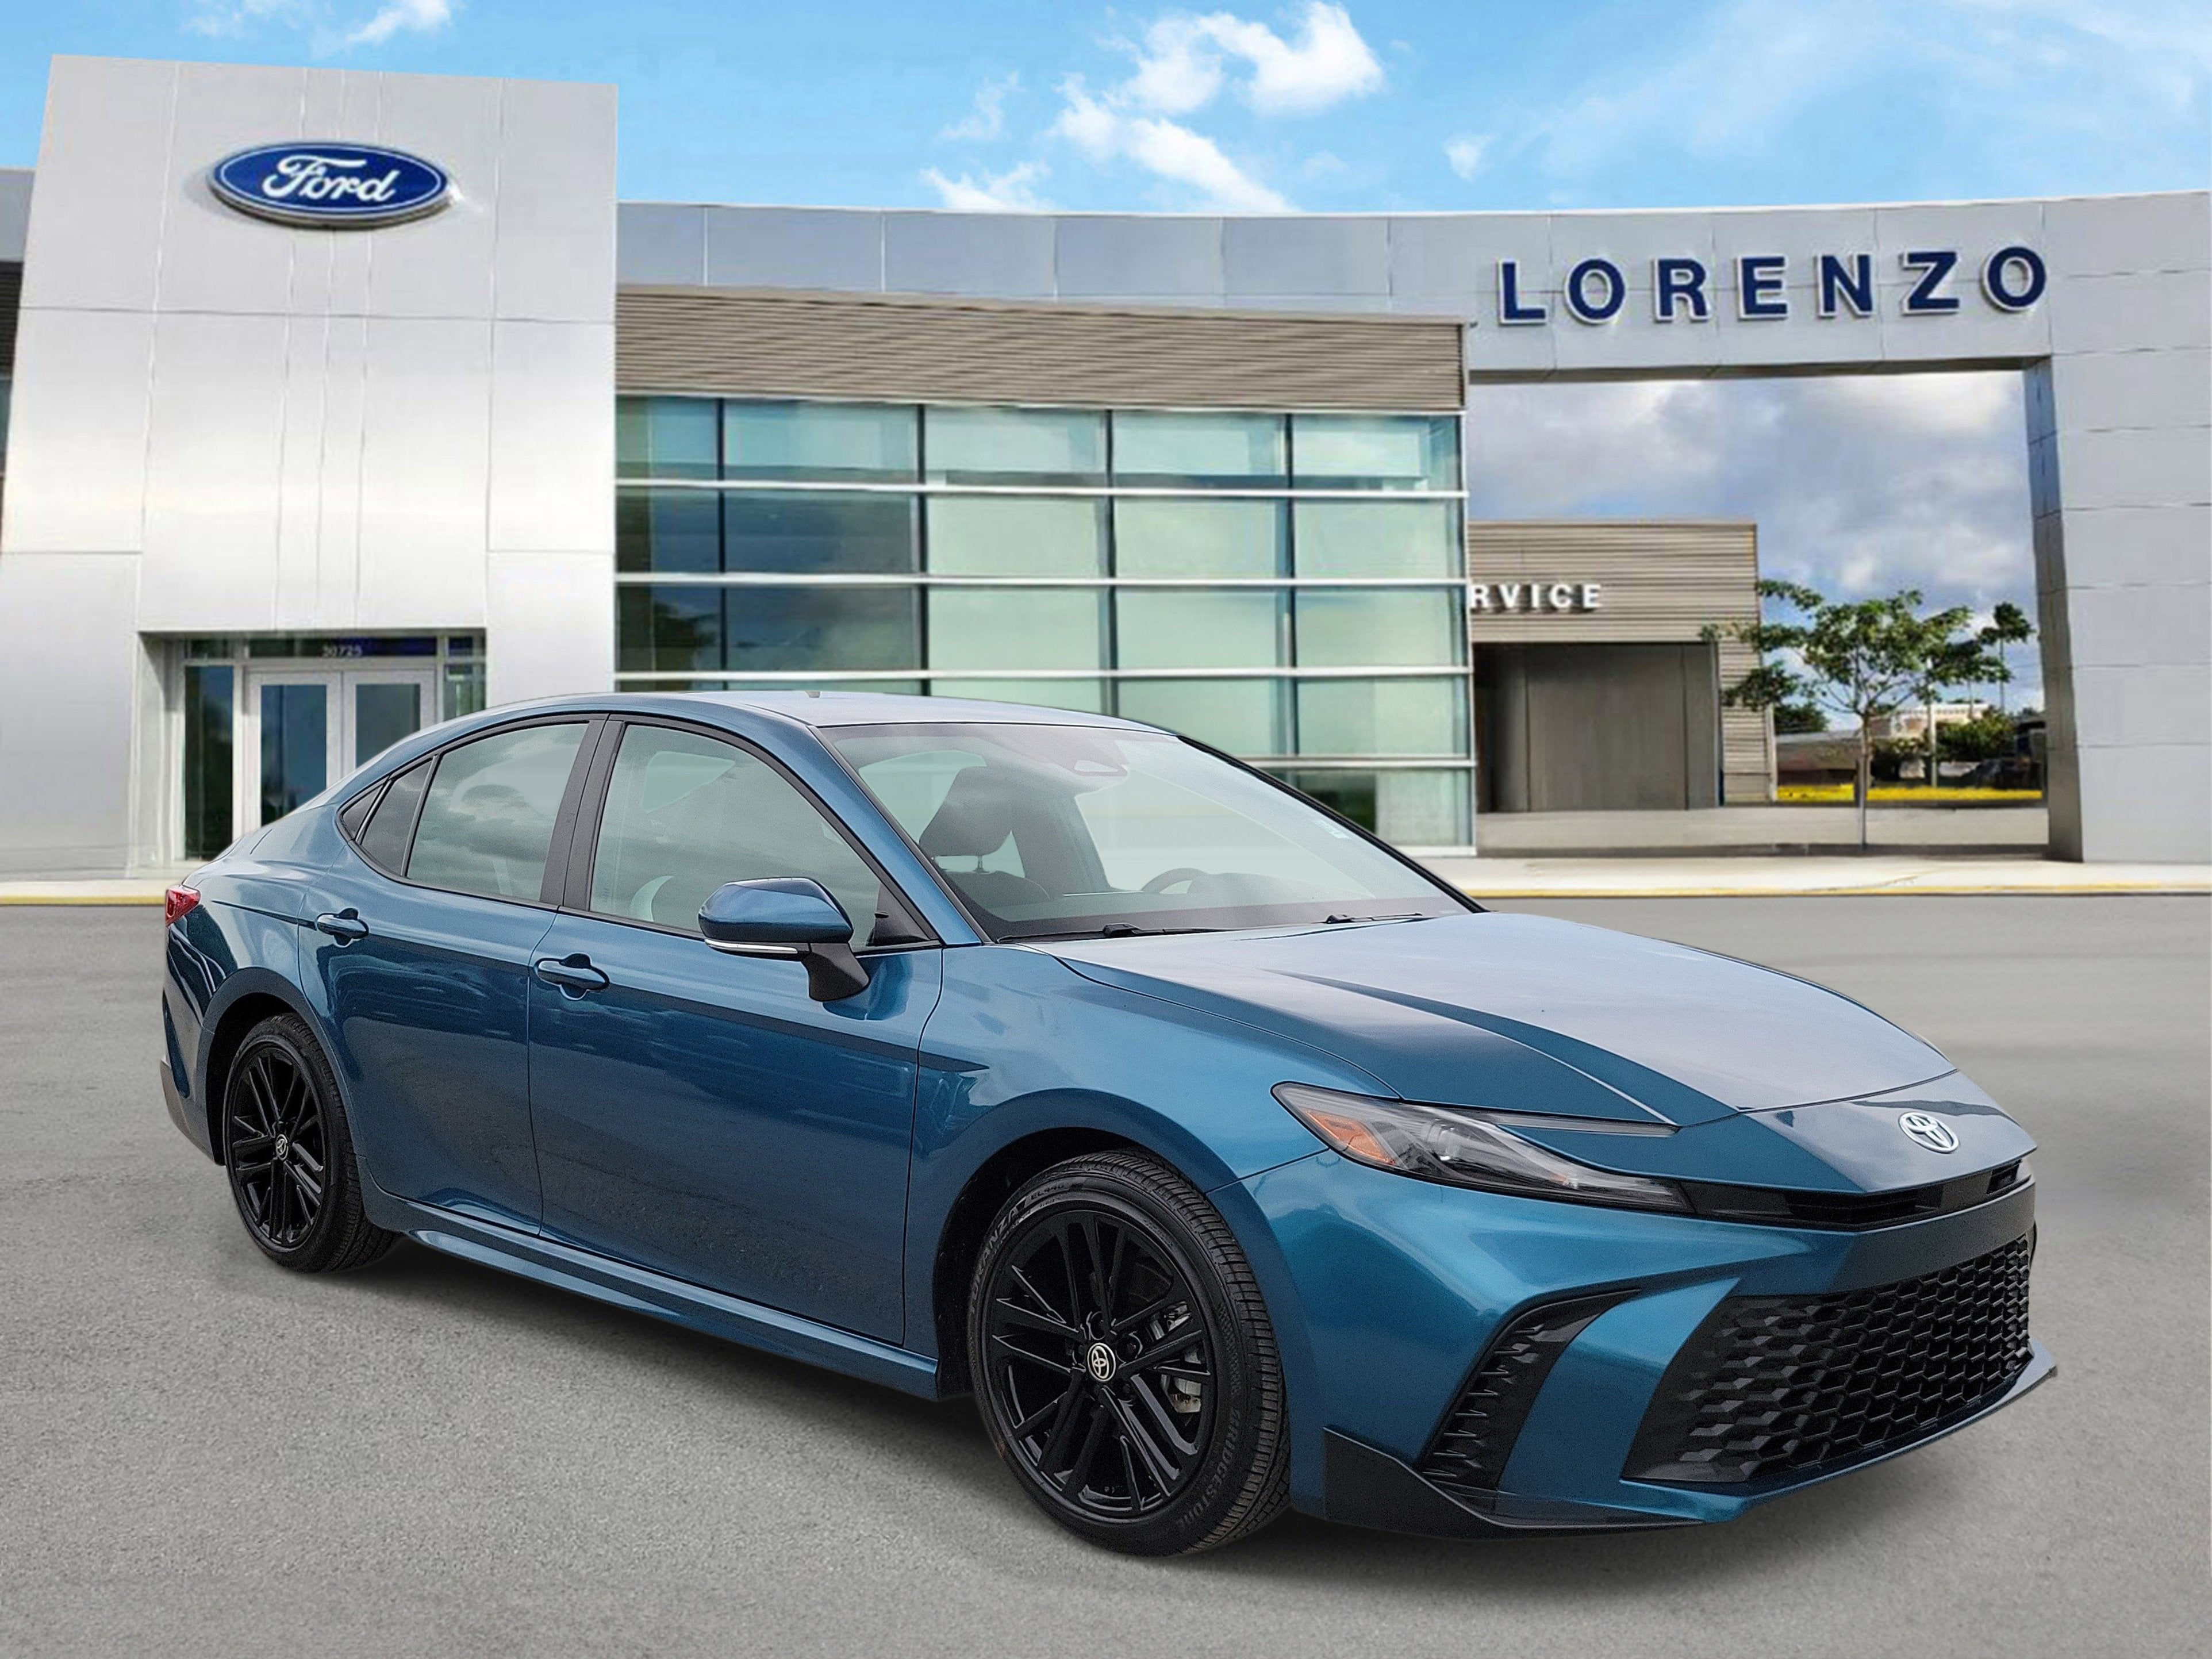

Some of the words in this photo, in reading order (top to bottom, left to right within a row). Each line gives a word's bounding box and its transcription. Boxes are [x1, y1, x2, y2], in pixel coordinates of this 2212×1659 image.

[262, 154, 400, 202] Ford
[1497, 245, 2047, 325] LORENZO
[1469, 583, 1602, 609] RVICE
